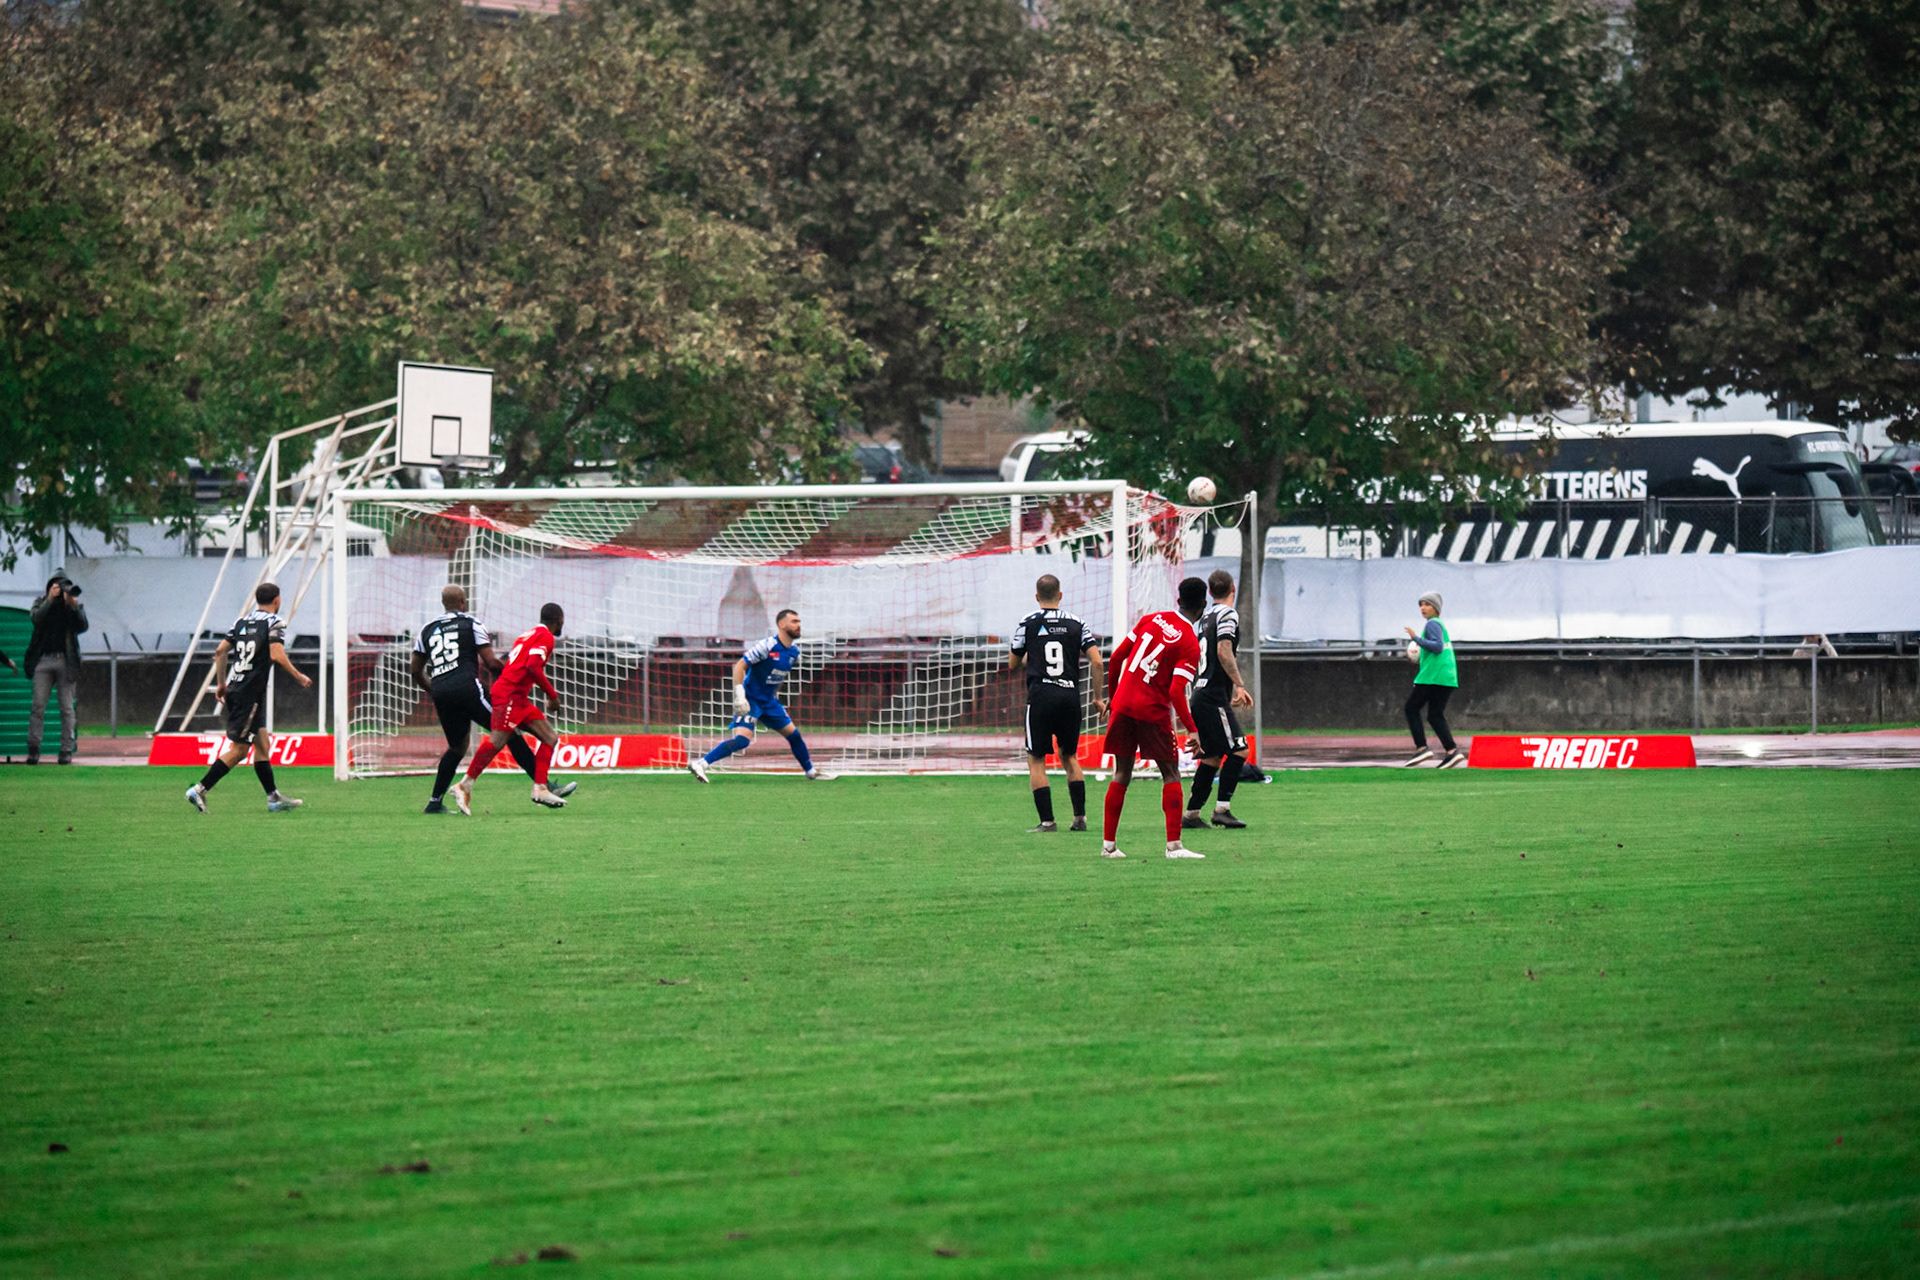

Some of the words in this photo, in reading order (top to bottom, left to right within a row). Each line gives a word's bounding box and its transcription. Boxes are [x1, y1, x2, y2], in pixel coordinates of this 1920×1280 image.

[1267, 546, 1306, 555] FONSECA
[234, 640, 257, 673] 32
[428, 631, 460, 667] 25
[1044, 641, 1065, 677] 9
[1128, 631, 1166, 684] 14
